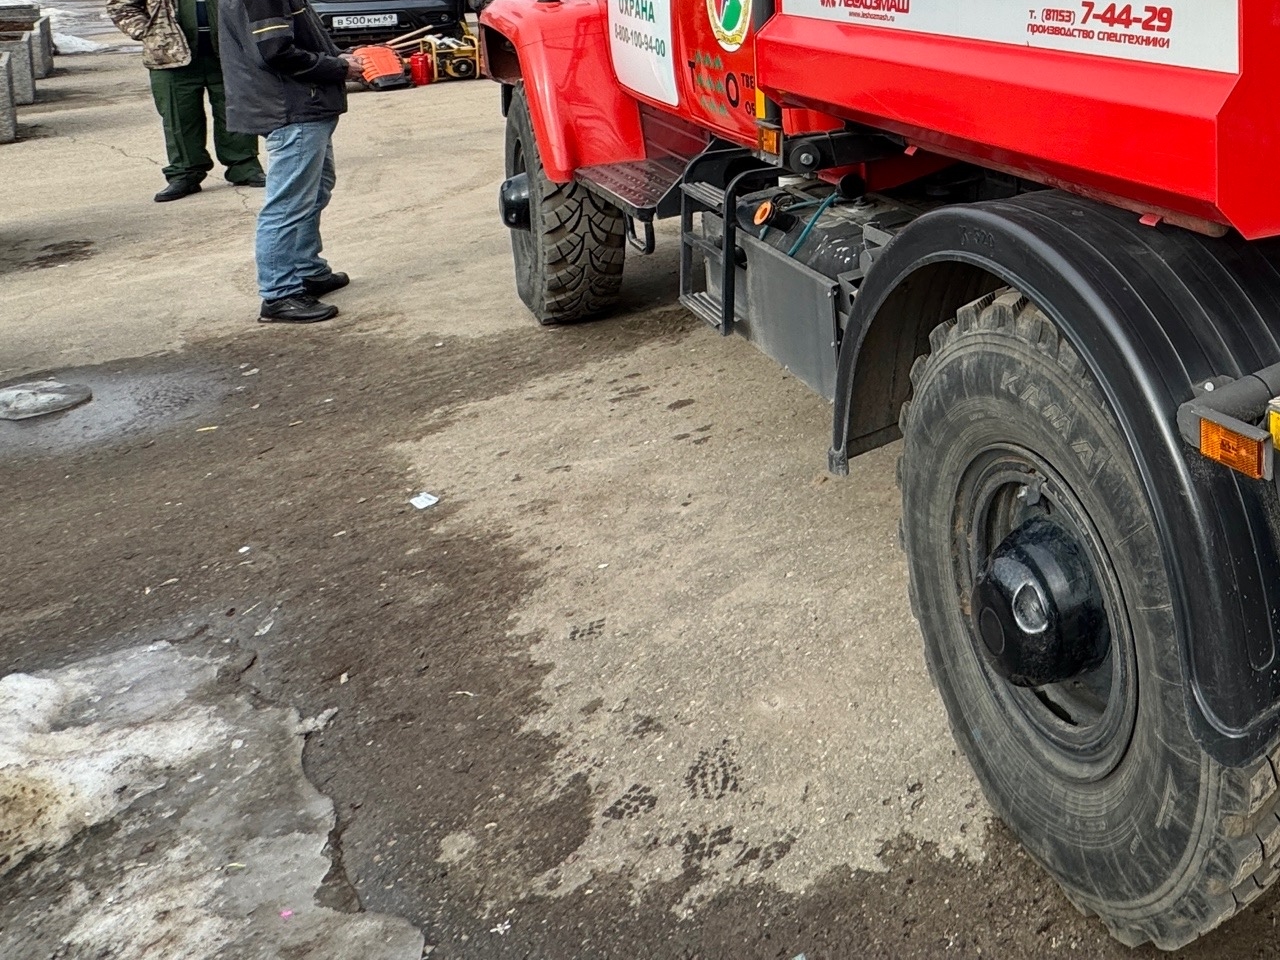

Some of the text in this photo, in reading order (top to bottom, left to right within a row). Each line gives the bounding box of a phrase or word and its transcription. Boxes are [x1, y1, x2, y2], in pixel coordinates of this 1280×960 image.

[1041, 8, 1076, 26] (81153)
[1081, 0, 1173, 33] 7-44-29
[1026, 23, 1171, 49] производство спецтехники
